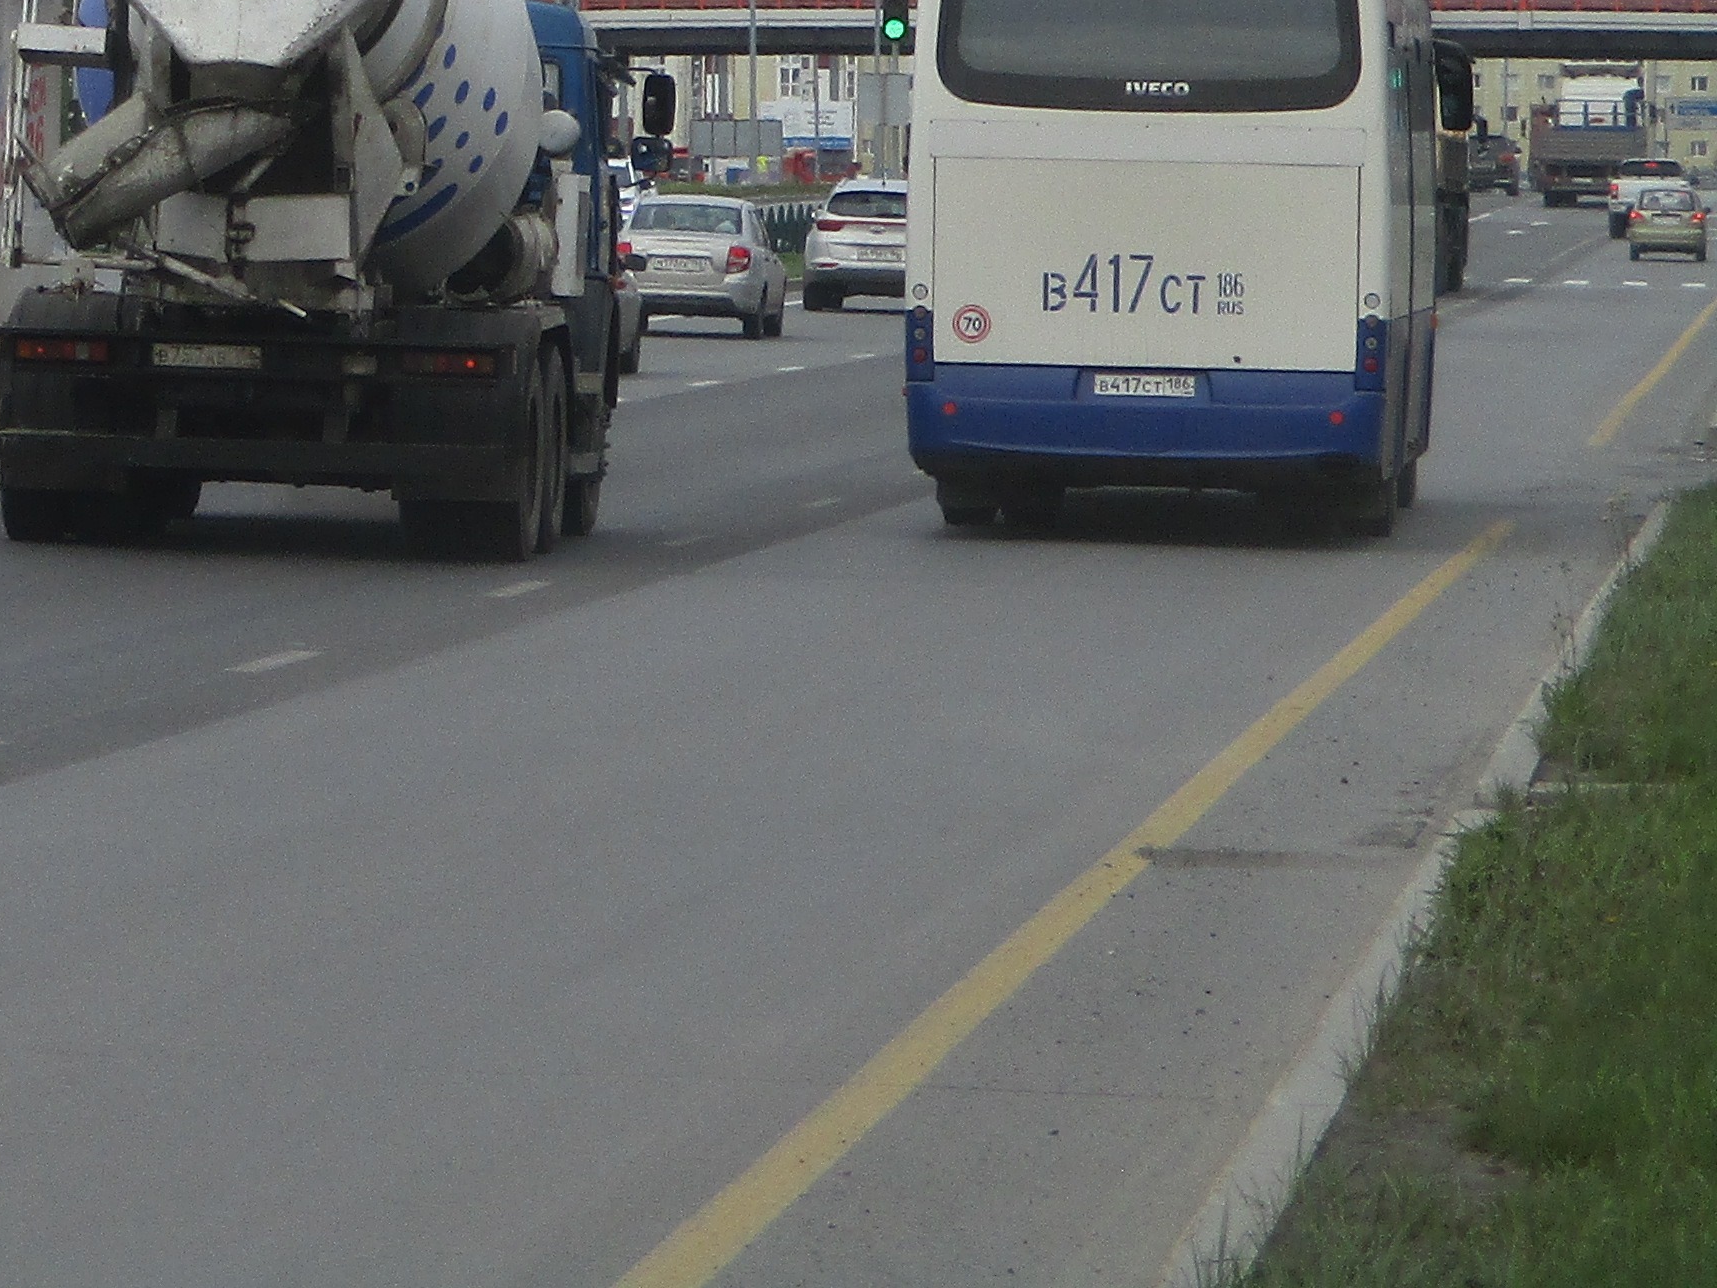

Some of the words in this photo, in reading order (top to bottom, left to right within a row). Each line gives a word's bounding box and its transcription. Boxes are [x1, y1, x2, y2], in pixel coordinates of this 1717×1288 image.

[1125, 81, 1191, 96] IVECO
[1041, 253, 1207, 314] В417СТ
[1217, 272, 1245, 298] 186
[1216, 300, 1245, 315] RUS
[963, 316, 983, 332] 70
[1098, 376, 1163, 393] В417СТ
[1167, 377, 1192, 391] 186
